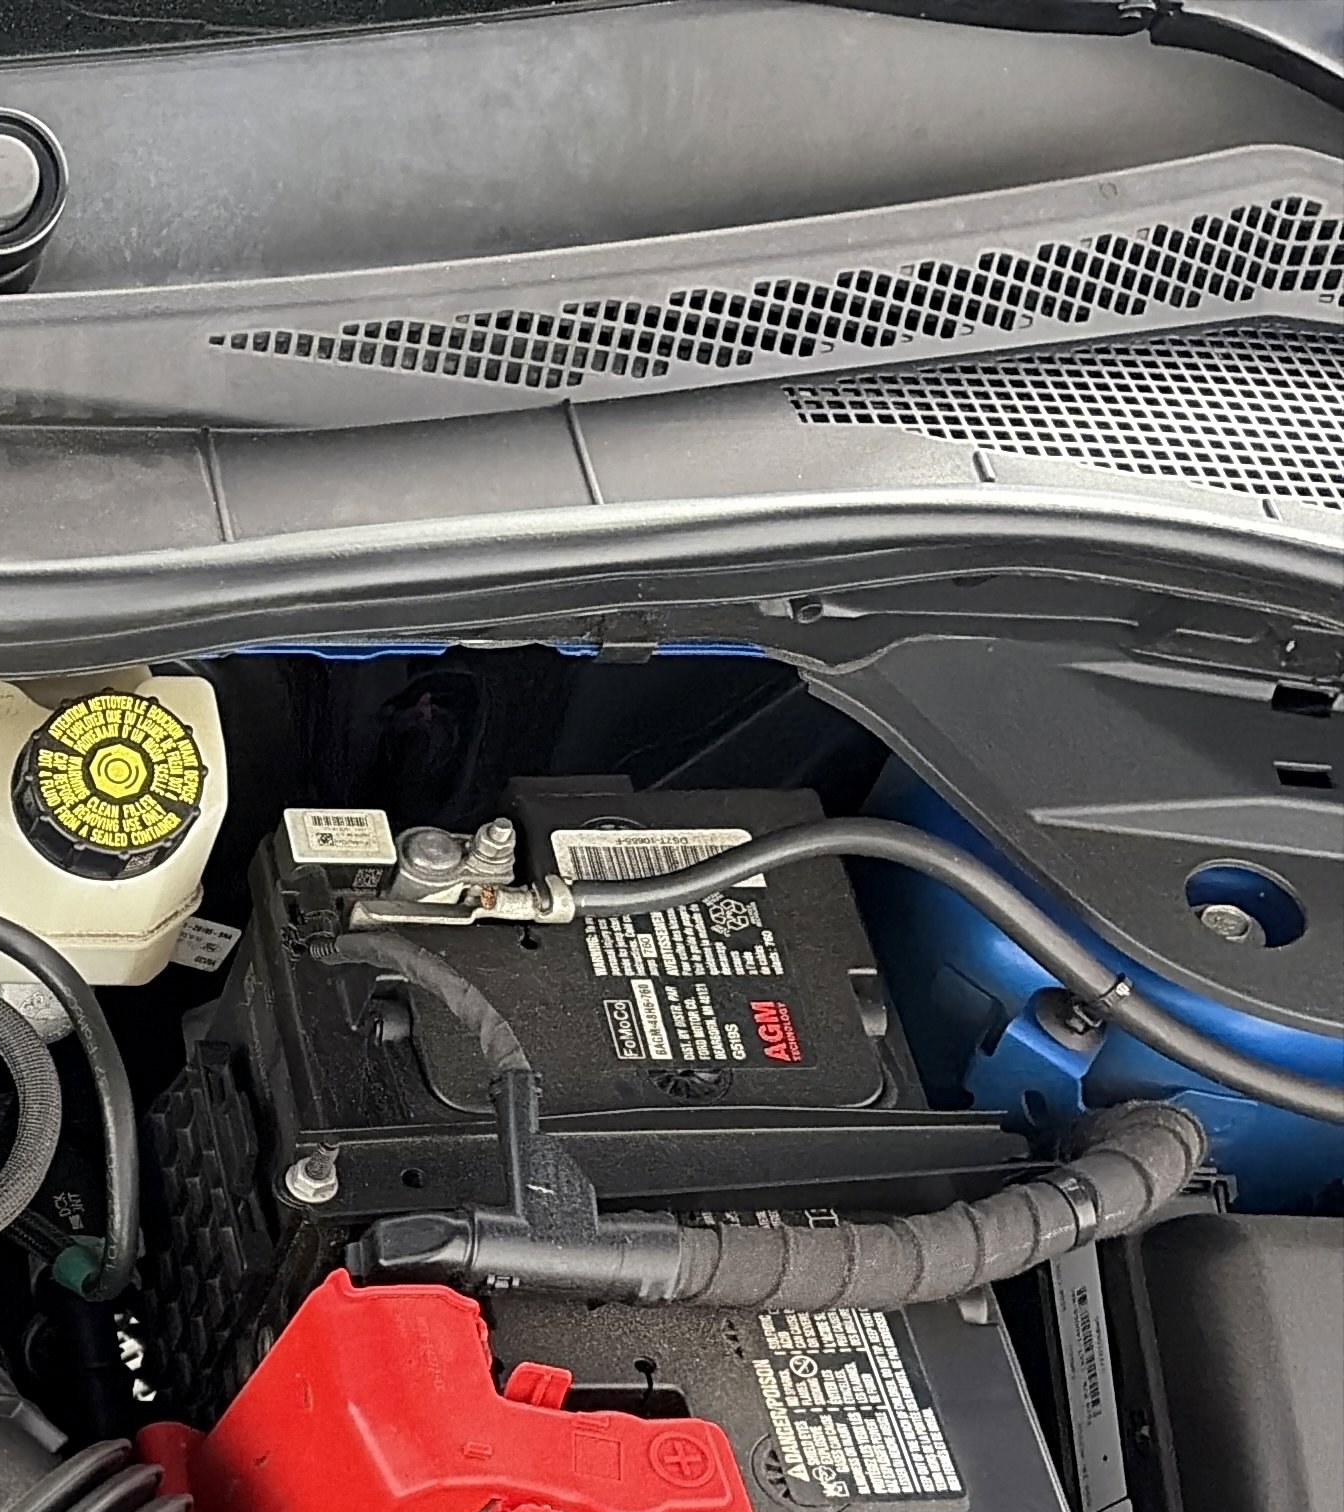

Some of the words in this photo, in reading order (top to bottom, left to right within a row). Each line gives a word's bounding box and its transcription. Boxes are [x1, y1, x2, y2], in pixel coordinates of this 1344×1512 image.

[88, 696, 133, 710] NETTOYER
[134, 699, 148, 715] LE
[125, 711, 137, 725] DU
[38, 749, 53, 768] DOT
[54, 752, 68, 770] CAP
[40, 780, 61, 807] FLUID
[54, 774, 78, 807] BEFORE
[68, 756, 90, 799] WARNING
[86, 797, 119, 818] CLEAN
[123, 794, 157, 818] FILLER
[54, 806, 81, 831] FROM
[73, 804, 119, 832] REMOVING
[122, 819, 142, 832] USE
[142, 805, 166, 827] ONLY
[79, 825, 88, 837] A
[90, 830, 128, 847] SEALED
[131, 813, 181, 845] CONTAINER
[640, 937, 653, 954] 760
[761, 930, 775, 946] 760
[684, 997, 697, 1009] CO.
[613, 1002, 638, 1057] FoMoCo
[676, 1028, 689, 1039] BY
[687, 1011, 705, 1037] MOTOR
[750, 1001, 791, 1061] AGM
[777, 1002, 801, 1061] TECHNOLOGY
[694, 1040, 711, 1060] FORD
[752, 1359, 803, 1463] DANGER/POISON
